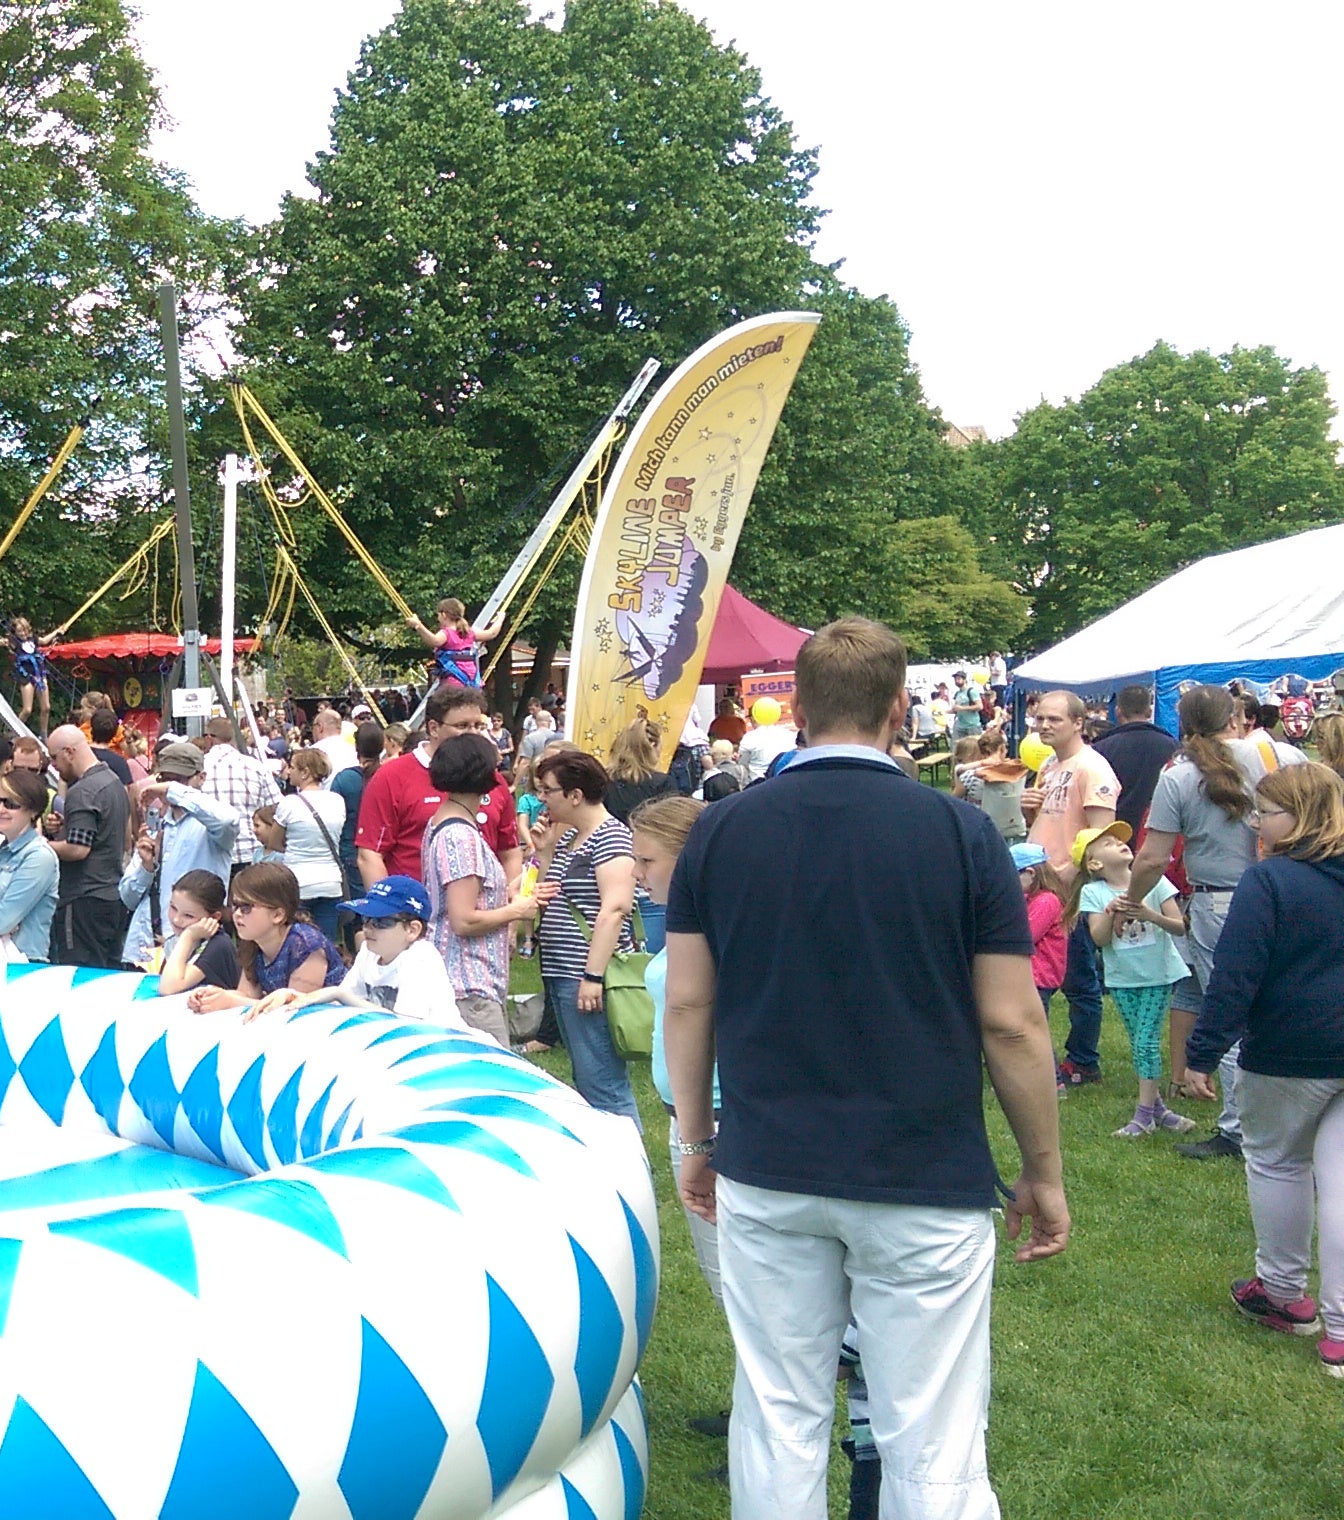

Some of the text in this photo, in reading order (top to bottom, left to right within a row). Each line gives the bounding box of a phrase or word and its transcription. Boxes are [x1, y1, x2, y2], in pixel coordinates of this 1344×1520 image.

[635, 336, 784, 491] Mich kann man mieten!
[608, 498, 656, 613] SKYLINE
[646, 477, 696, 587] JUMPER
[710, 536, 725, 552] by
[751, 680, 796, 692] EGGER
